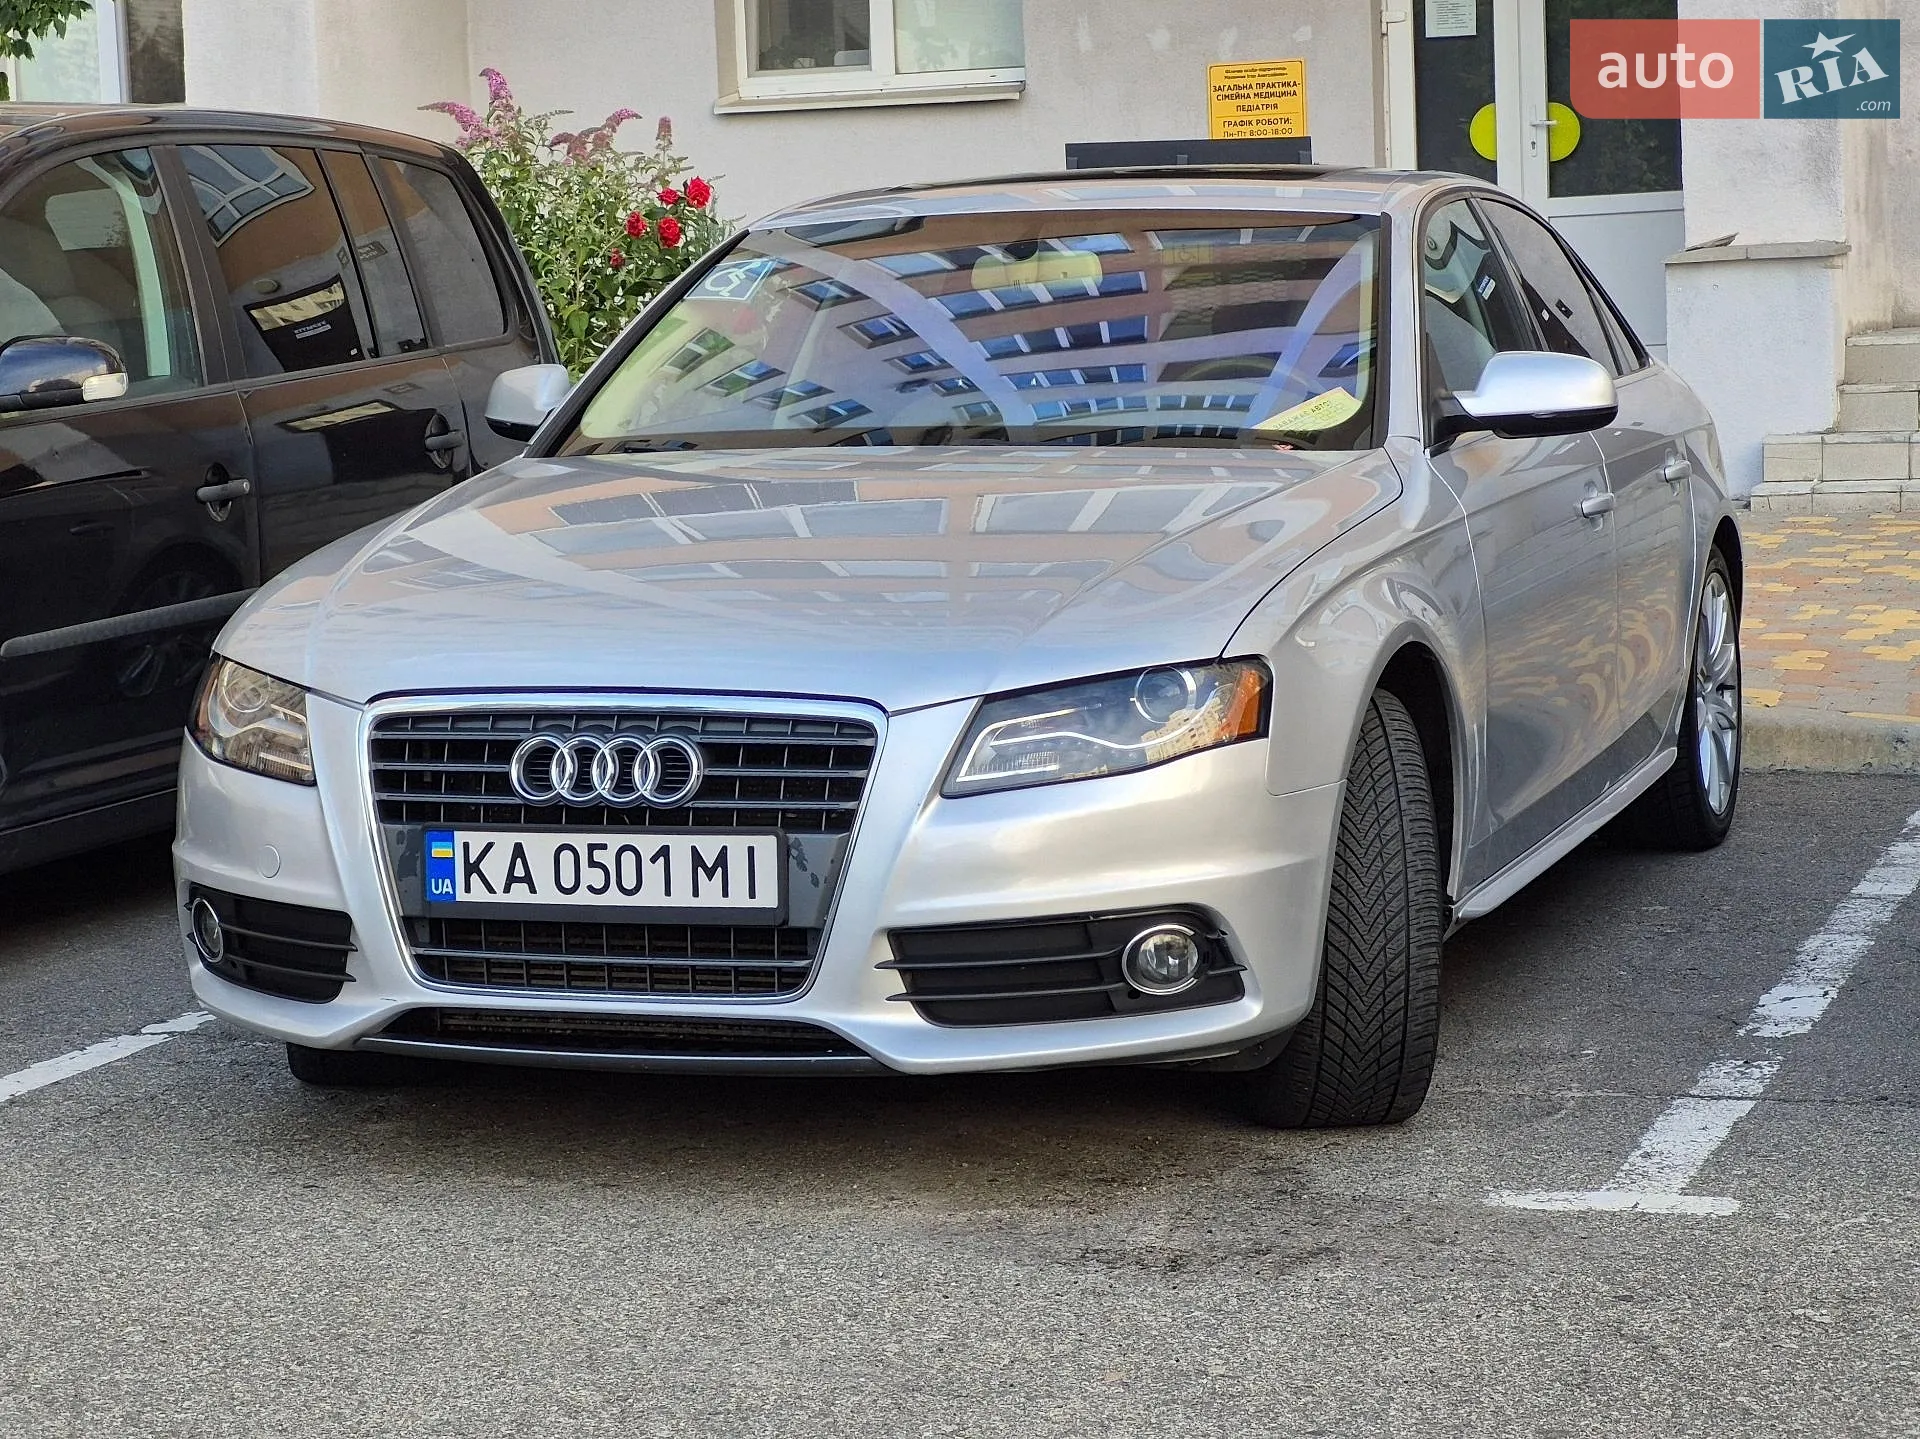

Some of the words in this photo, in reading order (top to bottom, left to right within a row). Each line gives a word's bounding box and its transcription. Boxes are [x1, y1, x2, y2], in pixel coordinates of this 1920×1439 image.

[1213, 83, 1253, 92] ЗАГАЛЬНА
[1256, 81, 1300, 90] ПРАКТИКА-
[1216, 92, 1251, 101] СІМЕЙНА
[1254, 90, 1297, 99] МЕДИЦИНА
[1236, 103, 1278, 112] ПЕДІАТРІЯ
[1223, 119, 1254, 128] ГРАФІК
[1256, 117, 1292, 126] РОБОТИ:
[462, 841, 538, 895] KA
[553, 842, 672, 897] 0501
[431, 878, 454, 896] UA
